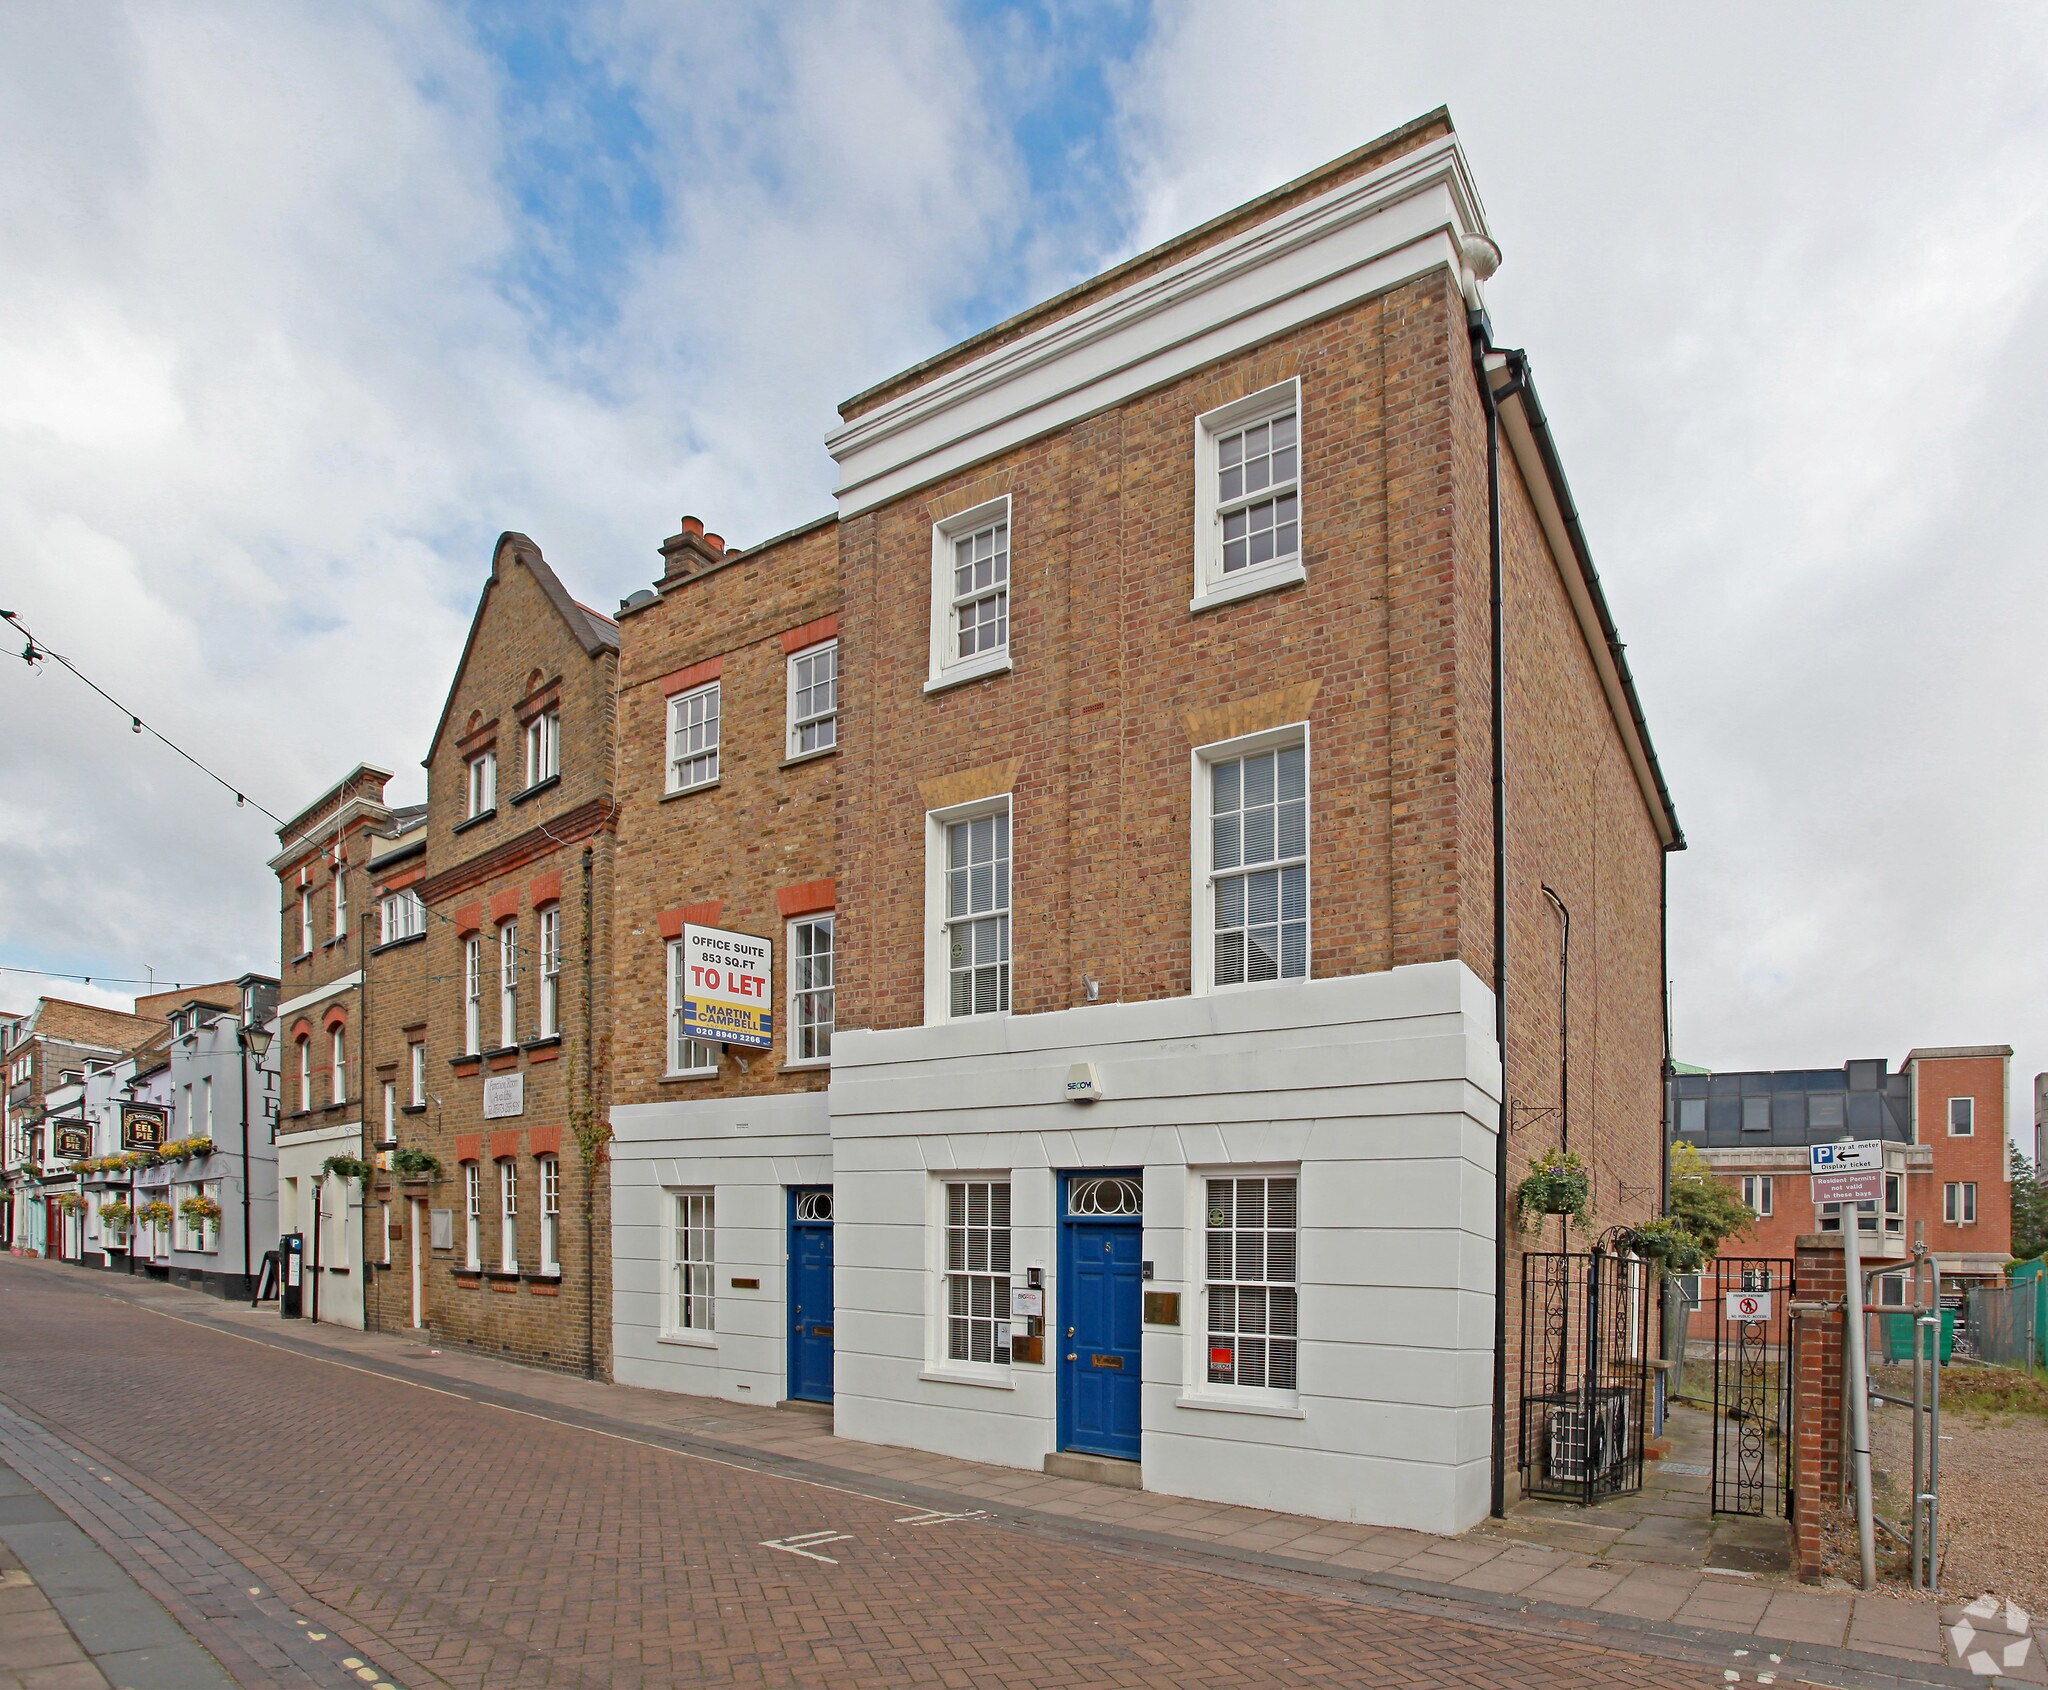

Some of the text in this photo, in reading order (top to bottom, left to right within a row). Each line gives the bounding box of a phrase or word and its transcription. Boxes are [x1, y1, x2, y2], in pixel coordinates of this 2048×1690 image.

[692, 936, 765, 958] OFFICE SUITE
[702, 952, 755, 970] 853 SQ.FT
[690, 965, 766, 998] TO LET
[705, 1004, 751, 1020] MARTIN
[698, 1012, 759, 1031] CAMPBELL
[695, 1027, 713, 1036] 020
[715, 1030, 738, 1040] 8940
[739, 1034, 761, 1044] 2266
[1067, 1081, 1092, 1090] SECOM
[135, 1124, 153, 1133] EEL
[136, 1132, 153, 1140] PIE
[65, 1136, 81, 1144] EEL
[1817, 1148, 1830, 1163] P
[1105, 1242, 1111, 1252] 5
